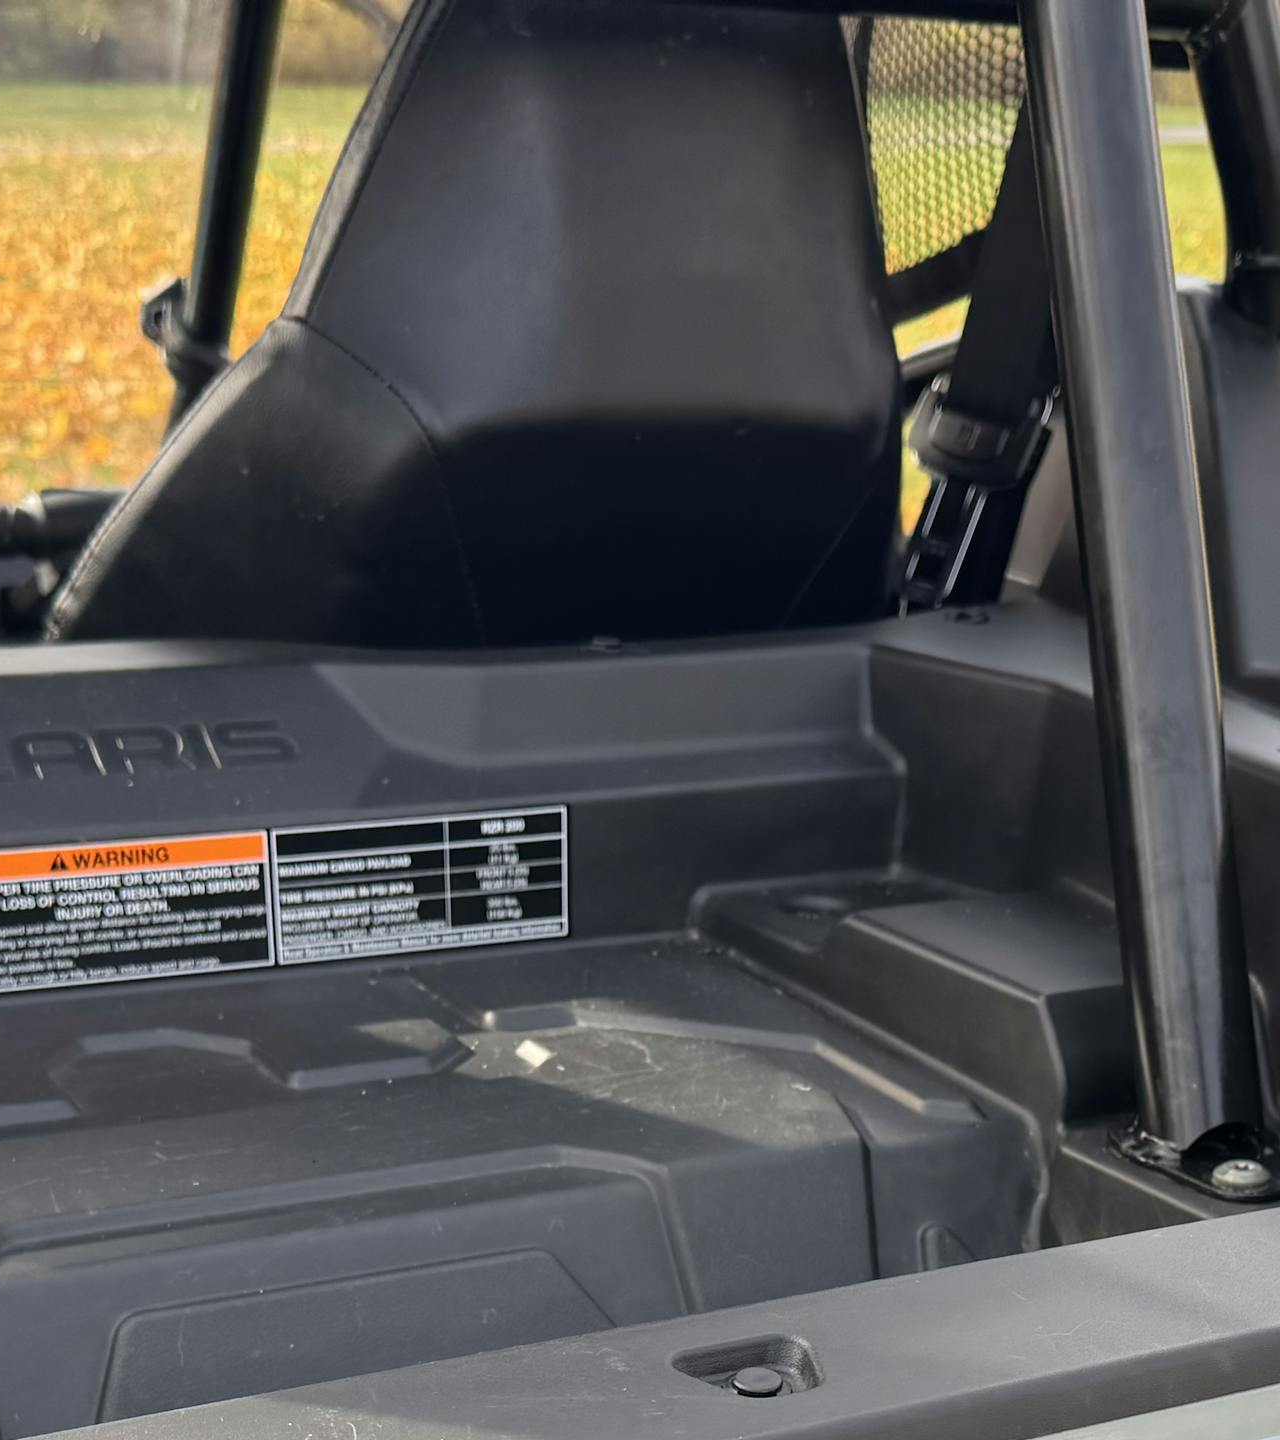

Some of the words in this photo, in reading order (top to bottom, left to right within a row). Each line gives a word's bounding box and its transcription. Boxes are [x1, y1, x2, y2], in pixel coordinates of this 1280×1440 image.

[72, 847, 169, 869] WARNING
[22, 880, 52, 895] TIRE
[53, 875, 120, 892] PRESSURE
[122, 873, 143, 887] OR
[144, 866, 231, 885] OVERLOADING
[232, 864, 260, 877] CAN
[0, 896, 36, 911] LOSS
[37, 895, 55, 908] OF
[120, 883, 190, 901] RESULTING
[190, 881, 205, 895] IN
[206, 877, 260, 894] SERIOUS
[53, 905, 102, 921] INJURY
[103, 902, 123, 917] OR
[125, 899, 171, 915] DEATH.
